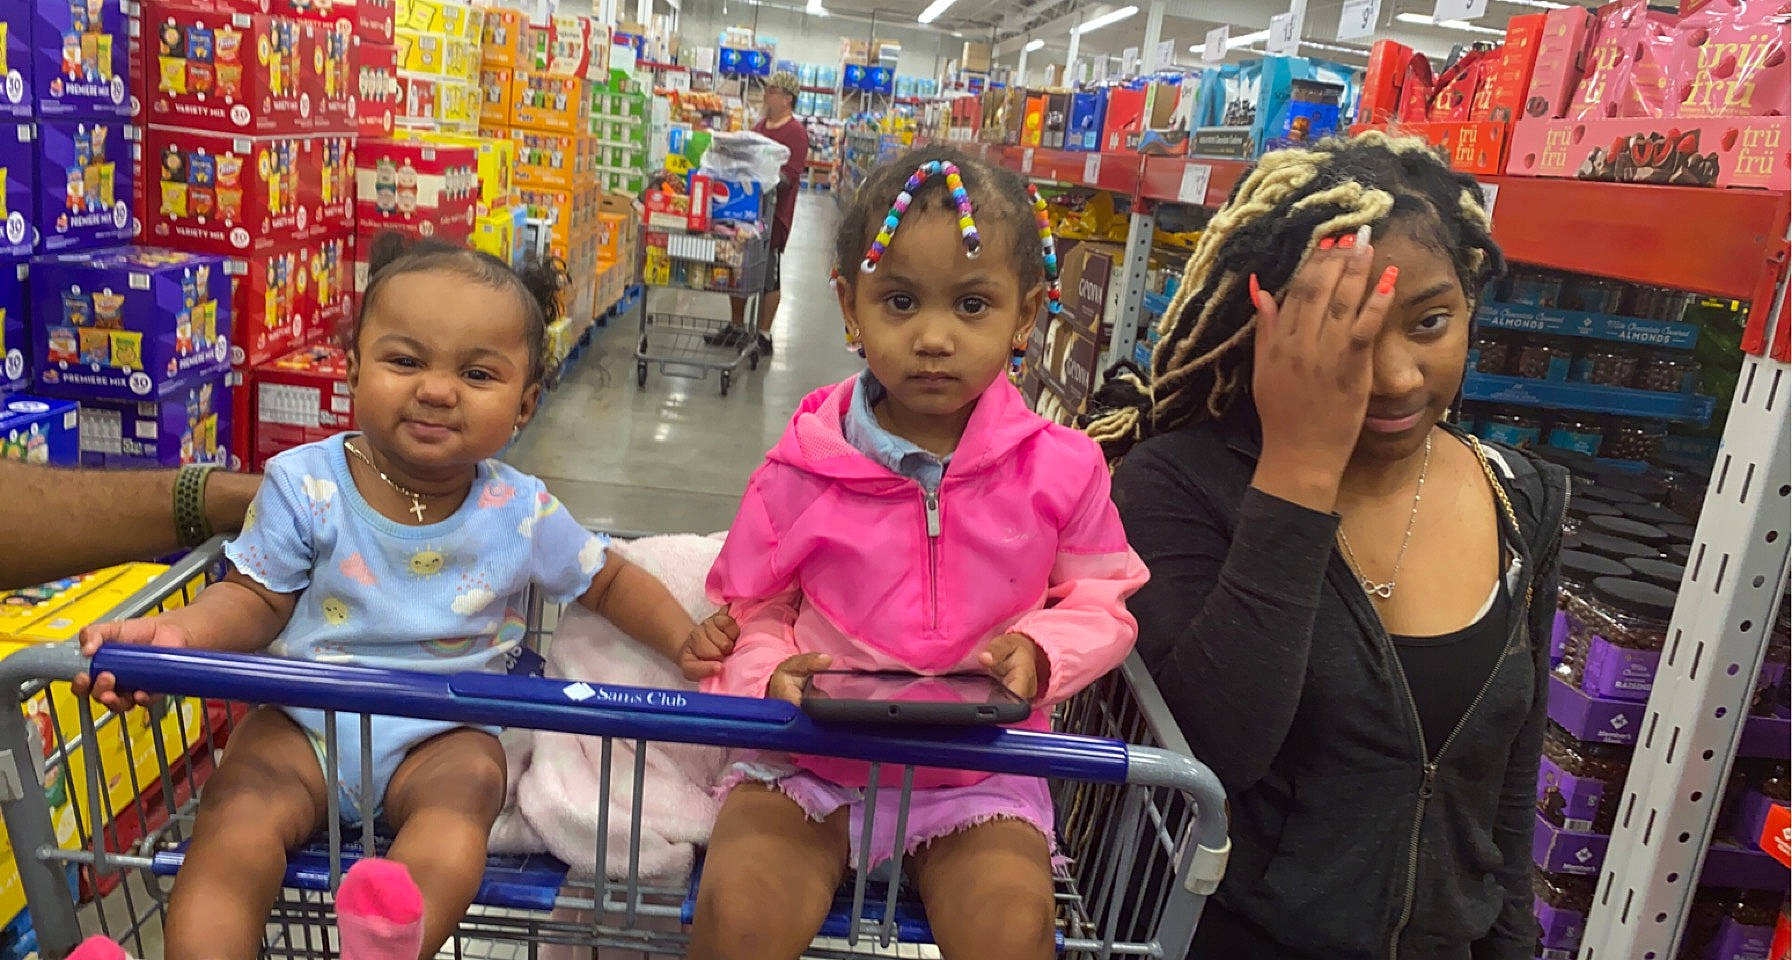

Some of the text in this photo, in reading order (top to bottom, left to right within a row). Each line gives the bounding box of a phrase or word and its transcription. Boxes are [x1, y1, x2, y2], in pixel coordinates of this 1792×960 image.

[175, 103, 226, 118] VARIETY MIX
[1460, 125, 1477, 143] trü
[1546, 126, 1572, 146] trü
[1743, 124, 1781, 148] trü
[1456, 143, 1475, 161] frü
[1541, 145, 1567, 168] frü
[1734, 148, 1774, 174] frü
[175, 225, 208, 239] VARIETY
[1491, 317, 1545, 330] ALMONDS
[1618, 330, 1671, 344] ALMONDS
[62, 372, 127, 388] PREMIERE MIX
[646, 691, 688, 707] Club
